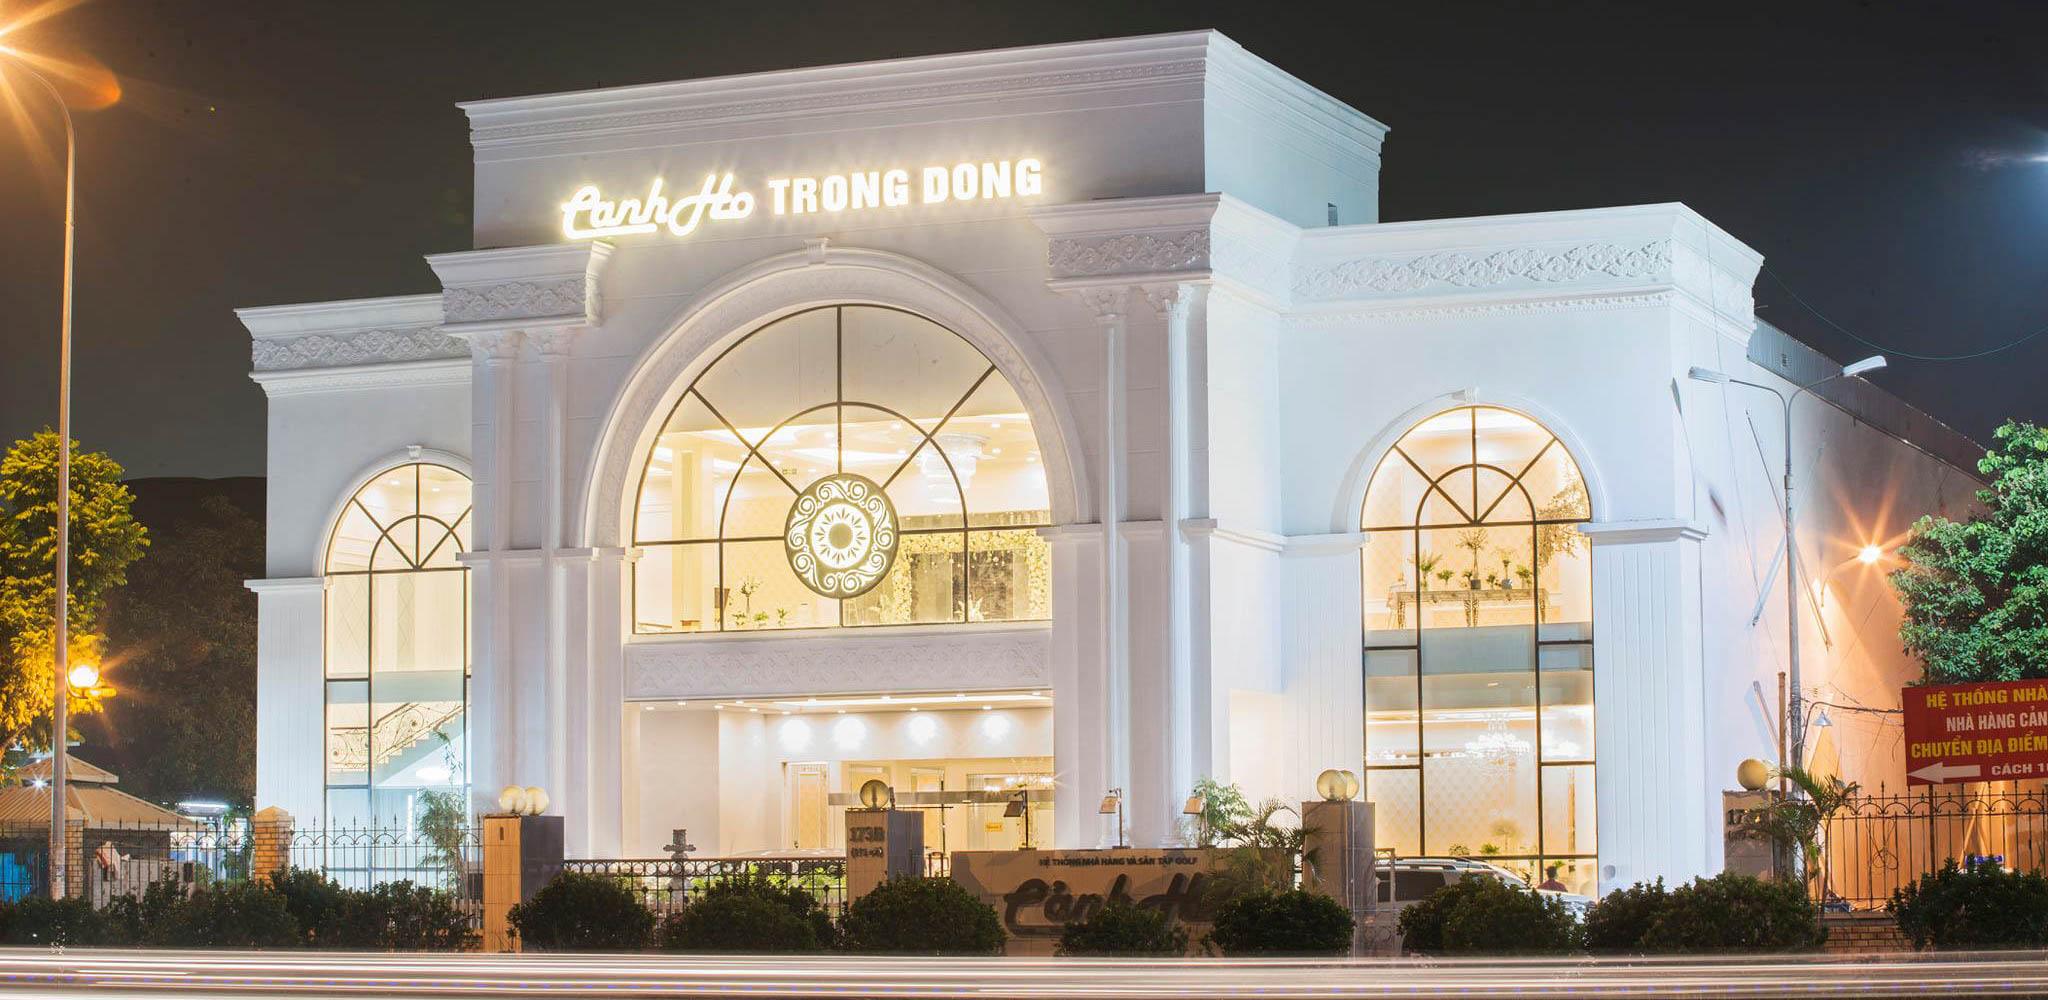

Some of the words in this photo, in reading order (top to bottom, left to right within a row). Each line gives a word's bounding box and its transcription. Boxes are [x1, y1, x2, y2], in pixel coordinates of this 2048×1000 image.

[768, 170, 909, 215] TRONG
[923, 158, 1042, 204] DONG
[1926, 691, 1947, 709] HỆ
[1952, 687, 2007, 707] THỐNG
[1946, 713, 1975, 732] NHÀ
[1978, 711, 2015, 730] HÀNG
[1911, 735, 1972, 758] CHUYỂN
[1977, 739, 2003, 757] ĐỊA
[1991, 762, 2032, 776] CÁCH
[1175, 857, 1198, 865] GOLF
